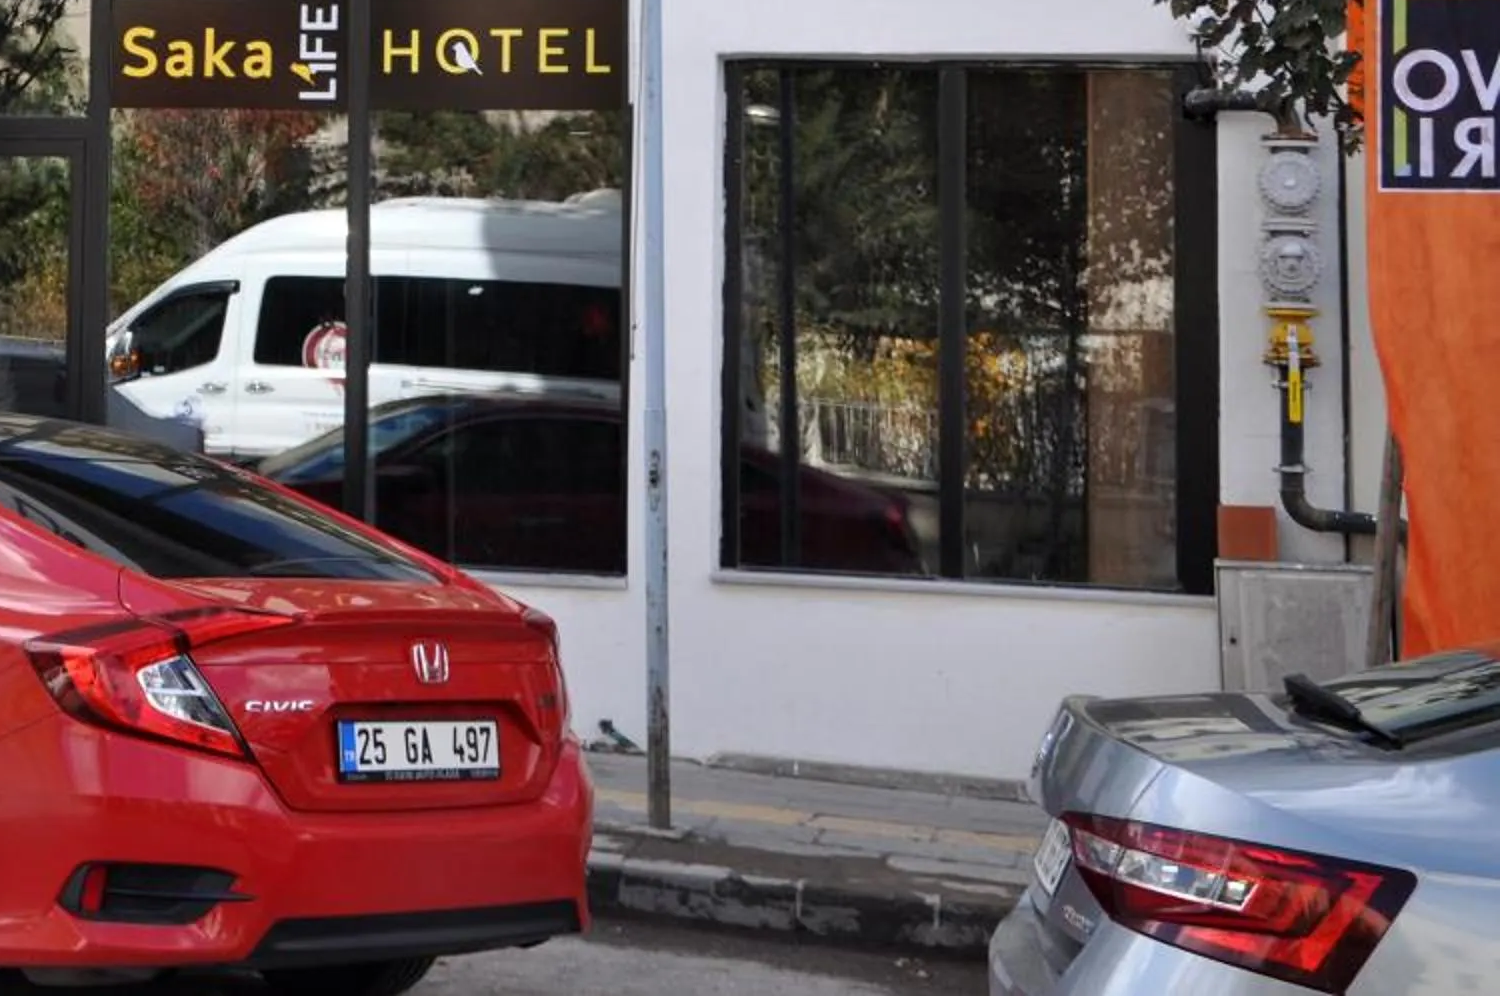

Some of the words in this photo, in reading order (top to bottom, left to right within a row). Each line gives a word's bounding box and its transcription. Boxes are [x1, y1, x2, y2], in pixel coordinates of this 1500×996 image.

[120, 26, 274, 78] Saka
[297, 3, 339, 101] LIFE
[382, 27, 612, 75] HOTEL
[245, 699, 313, 712] CIVIC
[357, 728, 387, 765] 25
[404, 727, 434, 764] GA
[453, 727, 491, 764] 497
